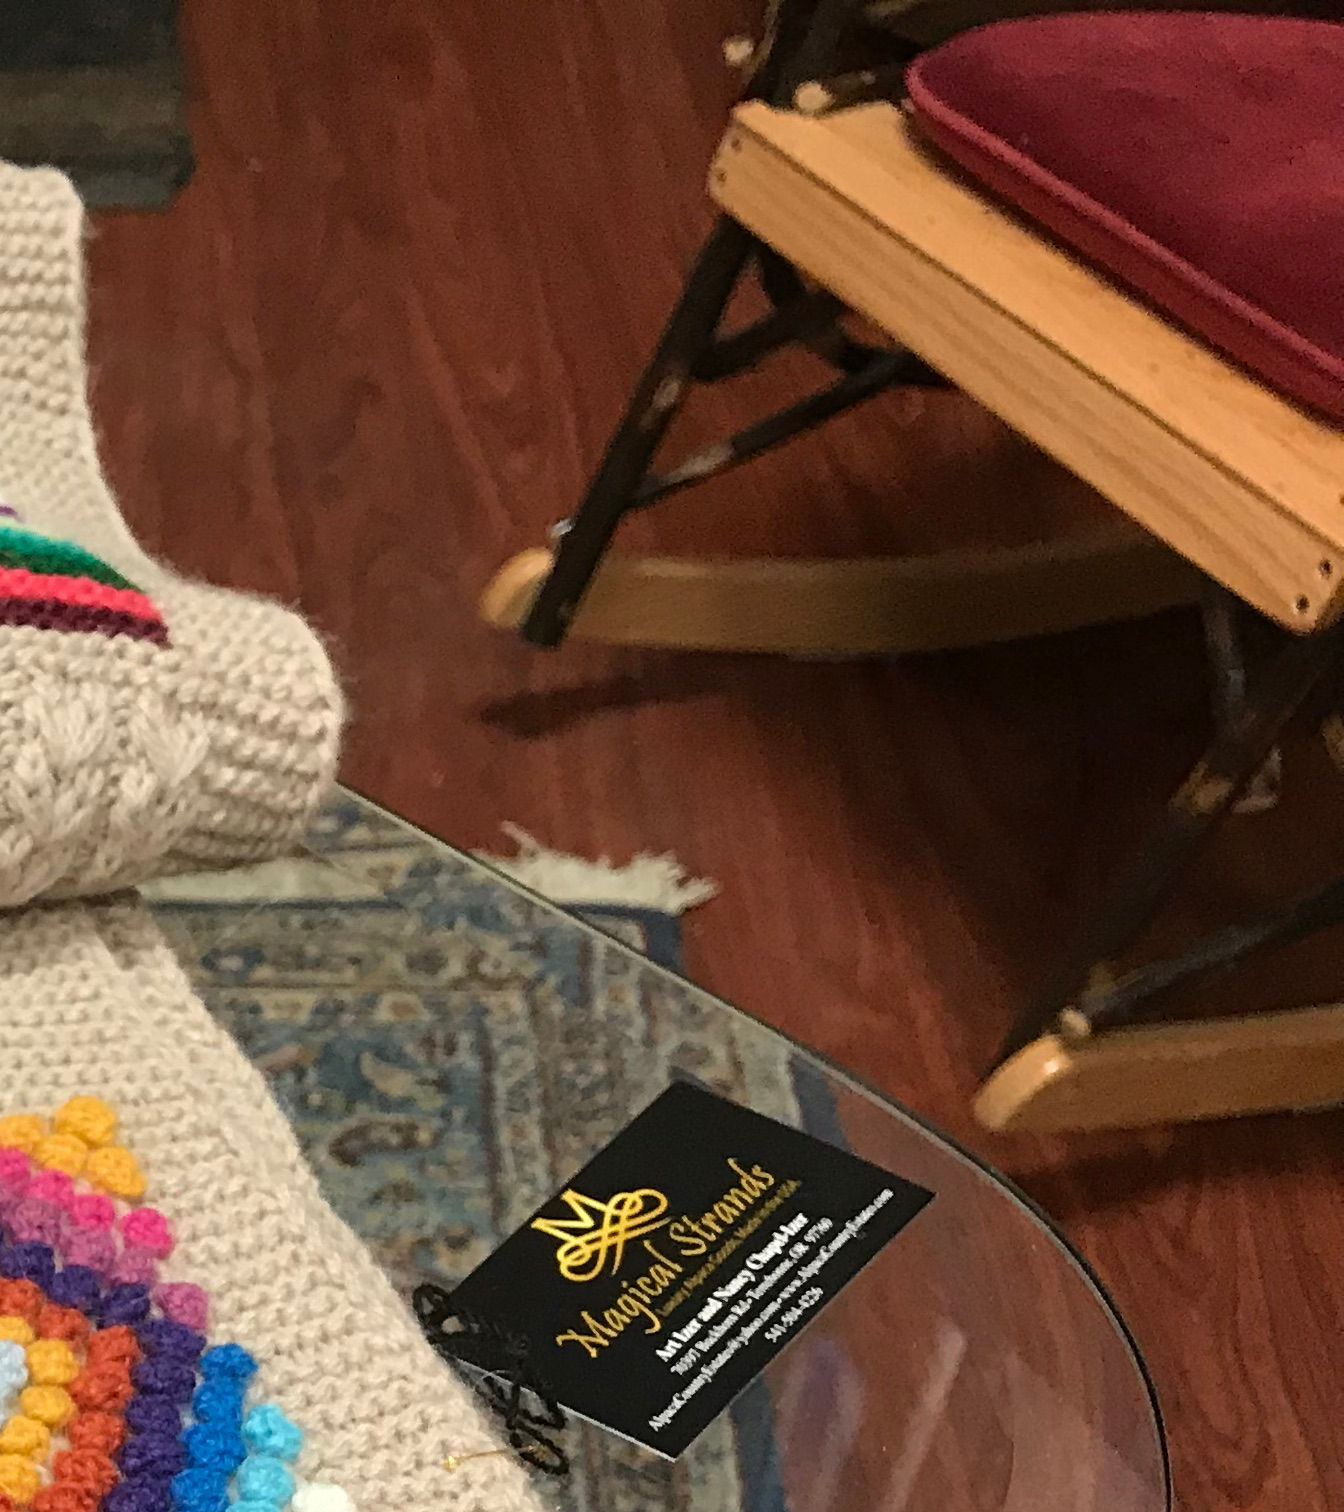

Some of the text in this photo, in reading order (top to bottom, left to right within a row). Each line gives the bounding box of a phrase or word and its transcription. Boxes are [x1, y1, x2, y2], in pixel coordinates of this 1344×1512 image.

[555, 1157, 774, 1358] Magical Strands
[655, 1339, 682, 1362] Art
[697, 1297, 722, 1321] and
[712, 1269, 755, 1302] Nancy
